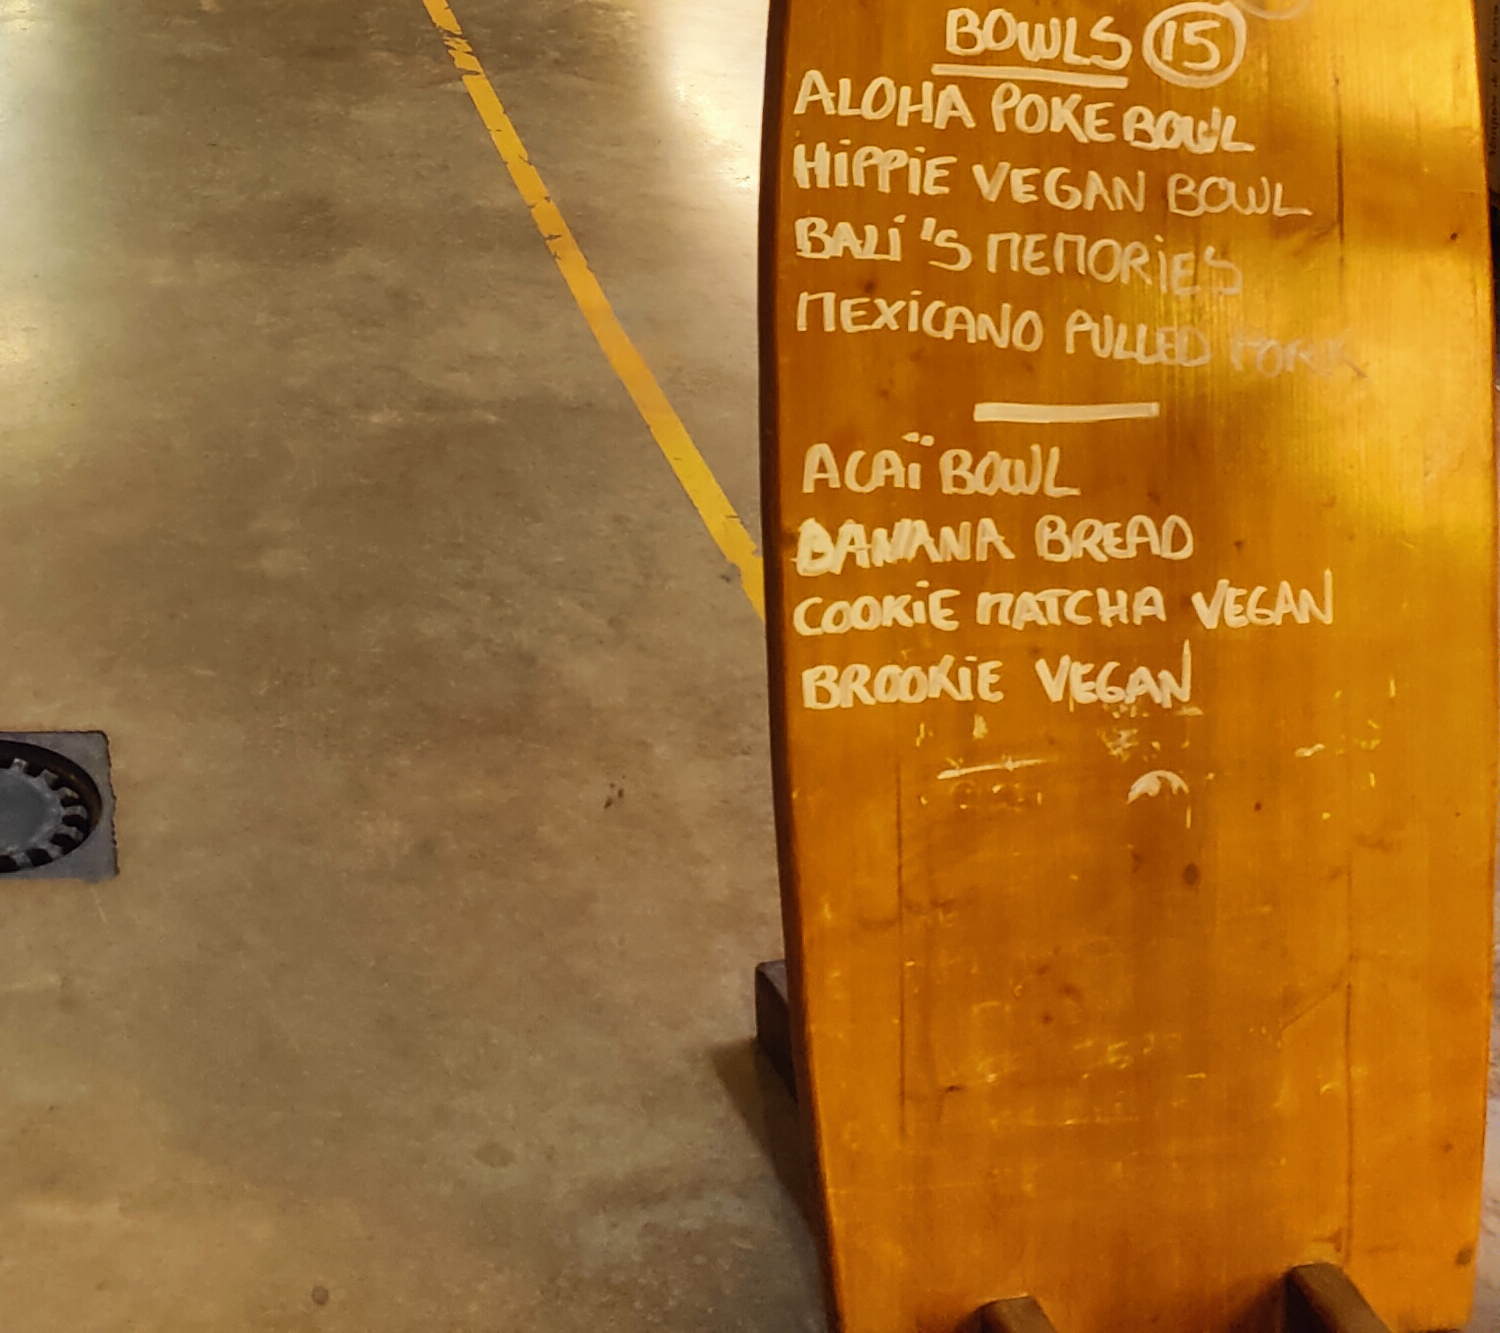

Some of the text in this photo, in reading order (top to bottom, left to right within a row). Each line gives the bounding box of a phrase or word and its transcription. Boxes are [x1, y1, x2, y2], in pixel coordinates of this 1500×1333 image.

[945, 5, 1221, 71] BOWLS 15
[793, 69, 1256, 154] ALOHA POKE BOWL
[972, 160, 1146, 213] VEGAN
[1167, 172, 1313, 219] BOWL
[1065, 306, 1211, 367] PULLED
[939, 443, 1081, 497] BOWL
[793, 514, 1194, 577] BANANA BREAD
[976, 585, 1167, 629] MATCHA
[1191, 567, 1334, 630] VEGAN
[1034, 638, 1192, 709] VEGAN
